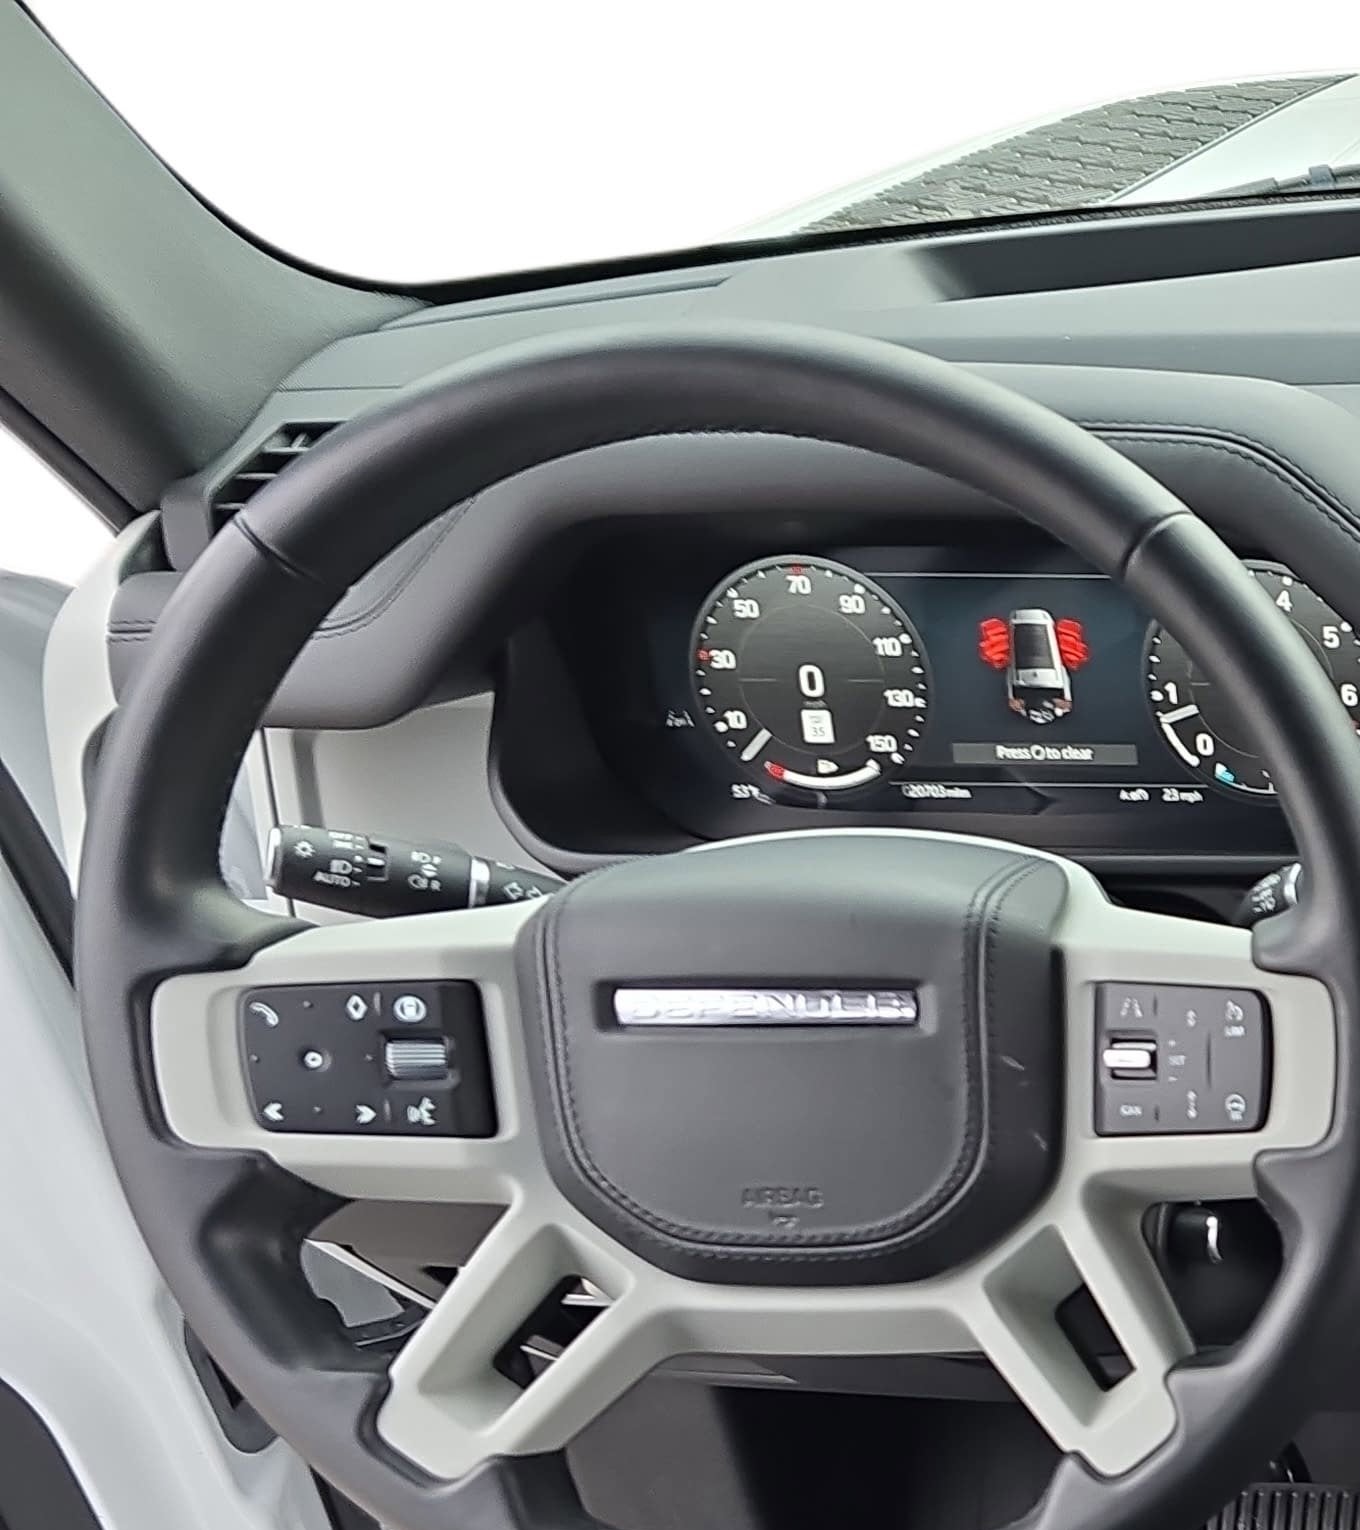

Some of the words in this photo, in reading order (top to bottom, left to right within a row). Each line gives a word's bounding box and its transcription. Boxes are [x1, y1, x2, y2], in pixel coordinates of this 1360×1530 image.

[786, 575, 812, 594] 70
[733, 600, 760, 619] 50
[839, 595, 866, 614] 90
[1276, 591, 1293, 611] 4
[1323, 625, 1340, 649] 5
[872, 637, 902, 657] 110
[711, 651, 737, 670] 30
[799, 664, 825, 698] 0
[884, 689, 914, 708] 130
[1167, 683, 1177, 704] 1
[1340, 684, 1357, 707] 6
[723, 710, 747, 730] 10
[866, 734, 898, 753] 150
[996, 744, 1033, 761] Press
[1062, 745, 1093, 761] clear
[1197, 735, 1214, 757] 0
[314, 871, 352, 888] AUTO
